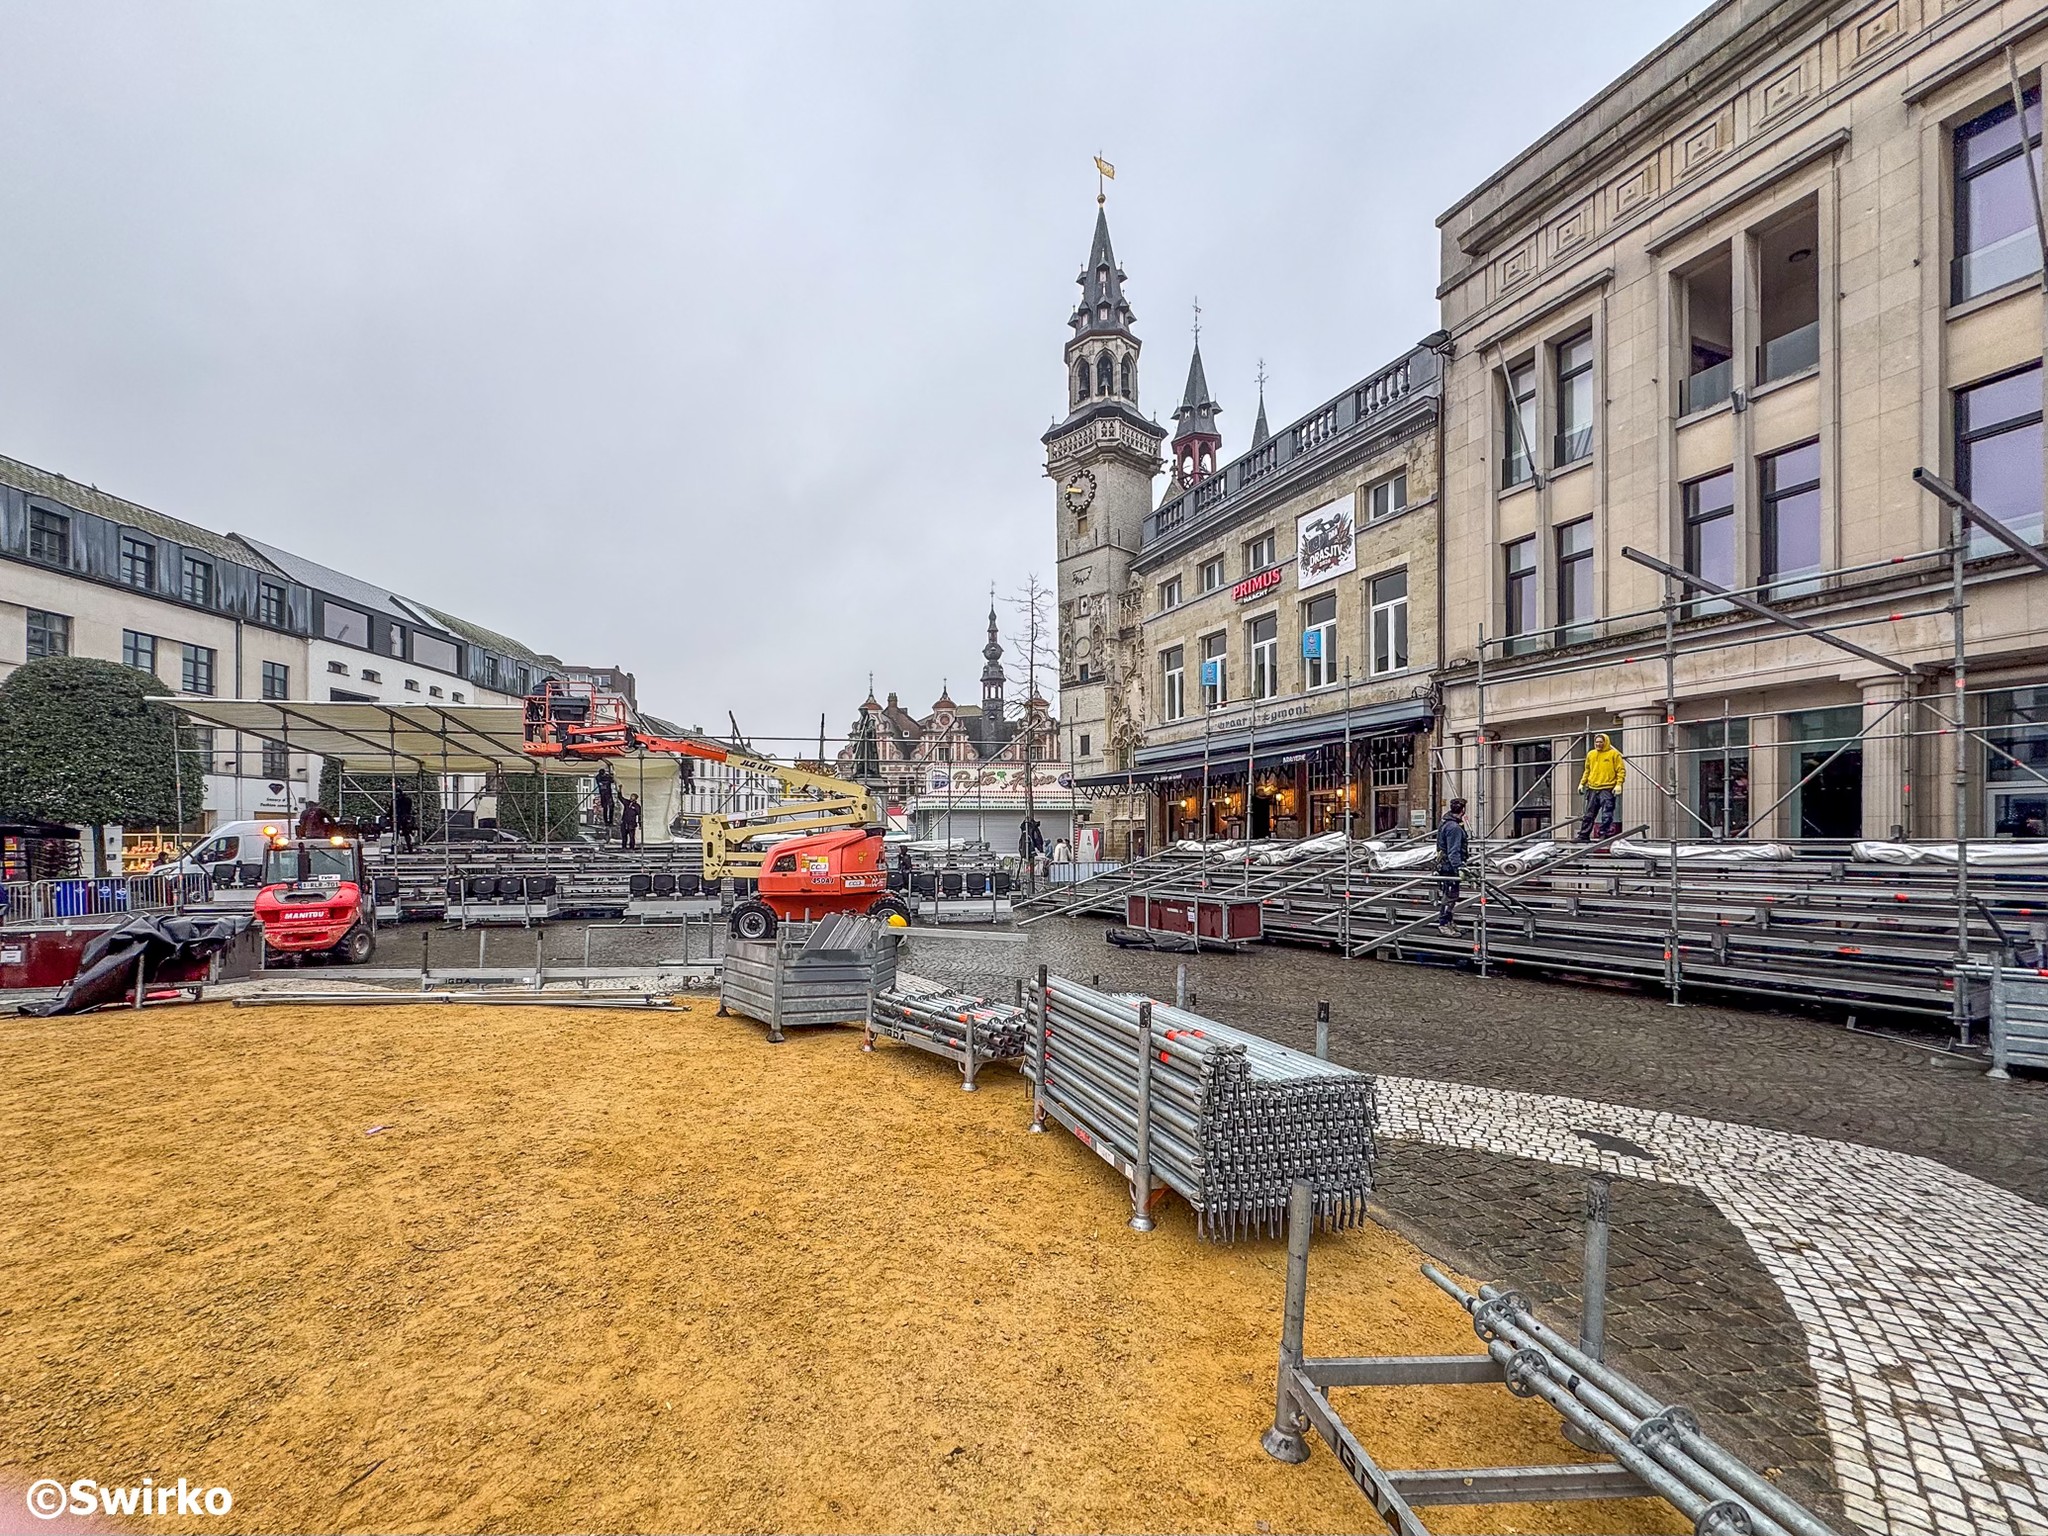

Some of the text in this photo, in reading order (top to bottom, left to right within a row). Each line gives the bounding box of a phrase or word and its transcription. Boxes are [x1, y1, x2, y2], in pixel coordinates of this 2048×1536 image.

[1232, 568, 1281, 601] PRIMUS
[1262, 703, 1310, 722] Egmont
[740, 759, 778, 773] JLG LIFT
[952, 770, 997, 789] Pasta
[284, 911, 324, 920] MANITOU
[884, 1027, 906, 1042] IGDA
